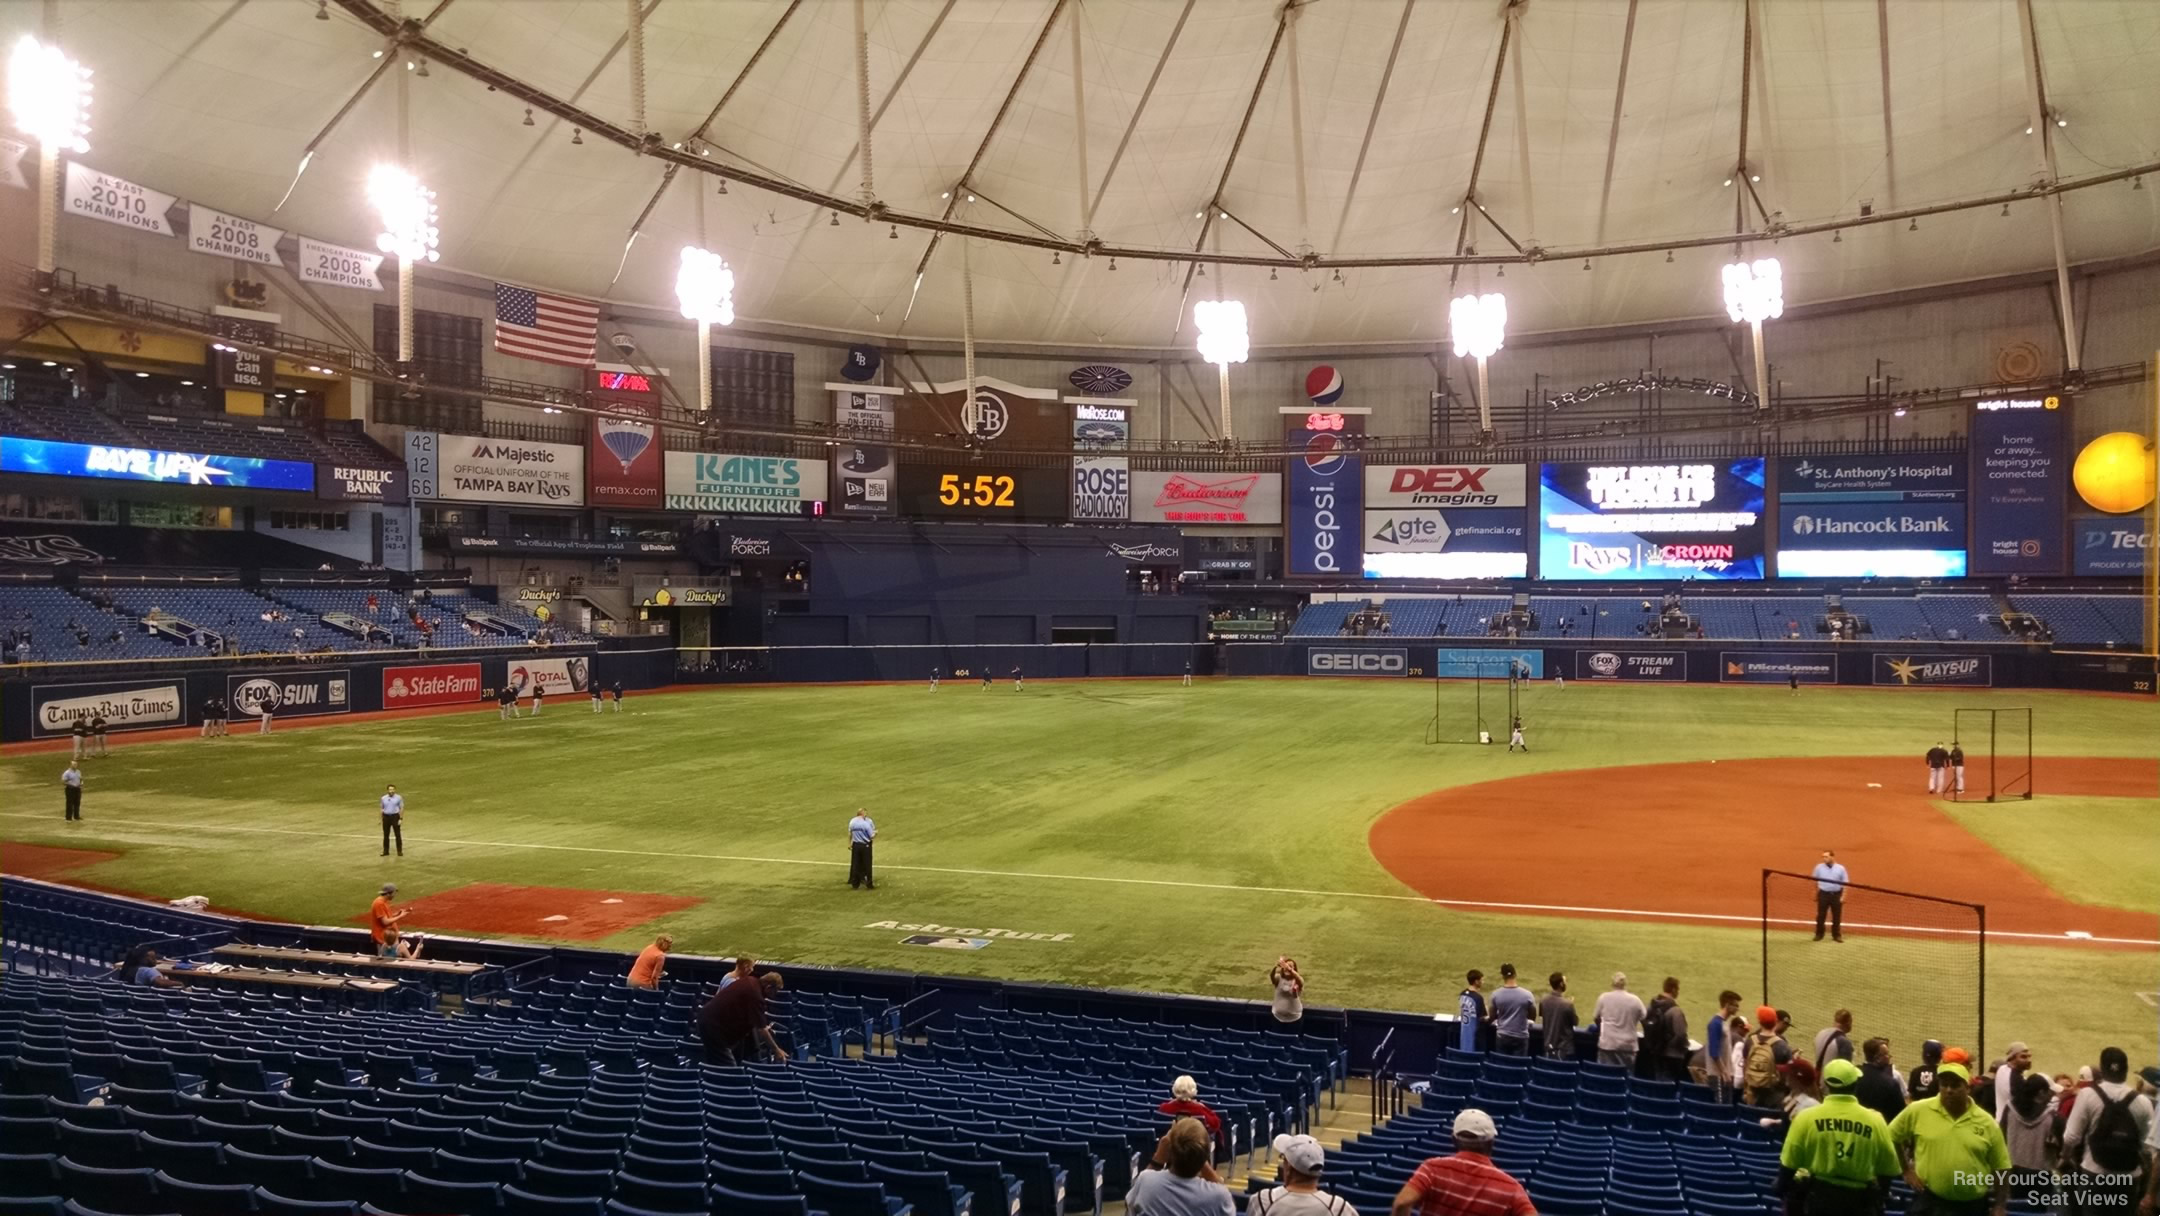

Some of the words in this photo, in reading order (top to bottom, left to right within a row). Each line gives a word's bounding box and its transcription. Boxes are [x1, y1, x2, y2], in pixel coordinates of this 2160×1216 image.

[97, 176, 111, 187] AL
[115, 181, 144, 196] EAST
[92, 186, 146, 214] 2010
[73, 198, 160, 230] CHAMPIONS
[215, 215, 227, 224] AL
[231, 218, 256, 231] EAST
[211, 224, 259, 248] 2008
[196, 237, 271, 263] CHAMPIONS
[306, 243, 343, 256] AMERICAN
[319, 255, 361, 275] 2008
[306, 267, 373, 287] CHAMPIONS
[236, 351, 260, 362] you
[854, 351, 866, 366] TB
[236, 362, 260, 373] can
[235, 373, 262, 386] use.
[847, 418, 884, 428] ON-FIELD
[975, 401, 1001, 431] TB
[412, 435, 431, 452] 42
[2002, 435, 2033, 444] home
[496, 446, 555, 464] Majestic
[855, 449, 865, 464] TB
[2007, 447, 2042, 456] away...
[87, 447, 150, 474] RAYS
[155, 453, 192, 478] UP
[414, 457, 429, 473] 12
[696, 454, 800, 485] KANE'S
[1985, 457, 2028, 468] keeping
[2030, 459, 2051, 468] you
[334, 467, 394, 483] REPUBLIC
[454, 464, 495, 476] OFFICIAL
[496, 467, 538, 478] UNIFORM
[540, 470, 551, 479] OF
[554, 472, 570, 480] THE
[1815, 468, 1832, 479] St.
[1834, 467, 1897, 481] Anthony's
[1899, 465, 1953, 480] Hospital
[1989, 468, 2048, 479] connected.
[346, 481, 382, 494] BANK
[412, 479, 432, 496] 66
[454, 478, 504, 492] TAMPA
[508, 481, 535, 494] BAY
[1074, 468, 1128, 495] ROSE
[1389, 468, 1491, 493] DEX
[1815, 481, 1842, 489] BayCare
[1843, 480, 1866, 488] Health
[1867, 480, 1892, 488] System
[595, 485, 657, 496] remax.com
[700, 485, 795, 496] FURNITURE
[939, 474, 1015, 506] 5:52
[1164, 482, 1249, 499] Budweiser
[1412, 492, 1499, 505] imaging
[1074, 495, 1127, 518] RADIOLOGY
[1164, 512, 1183, 521] THIS
[1310, 486, 1341, 572] pepsi
[1399, 517, 1437, 540] gte
[1455, 526, 1522, 536] gtefinancial.org
[1816, 517, 1898, 534] Hancock
[470, 538, 499, 547] Ballpark
[514, 539, 527, 547] The
[528, 539, 552, 548] Official
[553, 540, 567, 549] App
[568, 541, 575, 549] of
[574, 542, 606, 550] Tropicana
[607, 542, 625, 550] Field
[733, 536, 769, 545] Budweiser
[1406, 536, 1441, 545] financial
[1992, 541, 2018, 549] bright
[650, 544, 676, 552] Ballpark
[731, 545, 770, 555] PORCH
[1148, 548, 1179, 557] PORCH
[1662, 545, 1733, 559] CROWN
[520, 588, 561, 602] Ducky's
[686, 590, 726, 604] Ducky's
[1311, 653, 1404, 671] GEICO
[1448, 651, 1510, 668] Sagicor
[1596, 657, 1614, 665] FOX
[1628, 657, 1674, 666] STREAM
[955, 669, 969, 677] 404
[1409, 668, 1423, 676] 370
[1639, 666, 1663, 675] LIVE
[1748, 663, 1829, 671] MicroLumen
[532, 671, 567, 684] TOTAL
[2133, 681, 2149, 690] 322
[245, 686, 272, 701] FOX
[283, 684, 319, 705] SUN
[482, 688, 495, 698] 370
[47, 706, 97, 723] Tampa
[100, 701, 129, 720] Bay
[132, 698, 174, 716] Times
[863, 920, 1074, 942] AstroTurf
[1815, 1118, 1873, 1140] VENDOR
[1973, 1126, 1985, 1136] 39
[1836, 1140, 1854, 1159] 34
